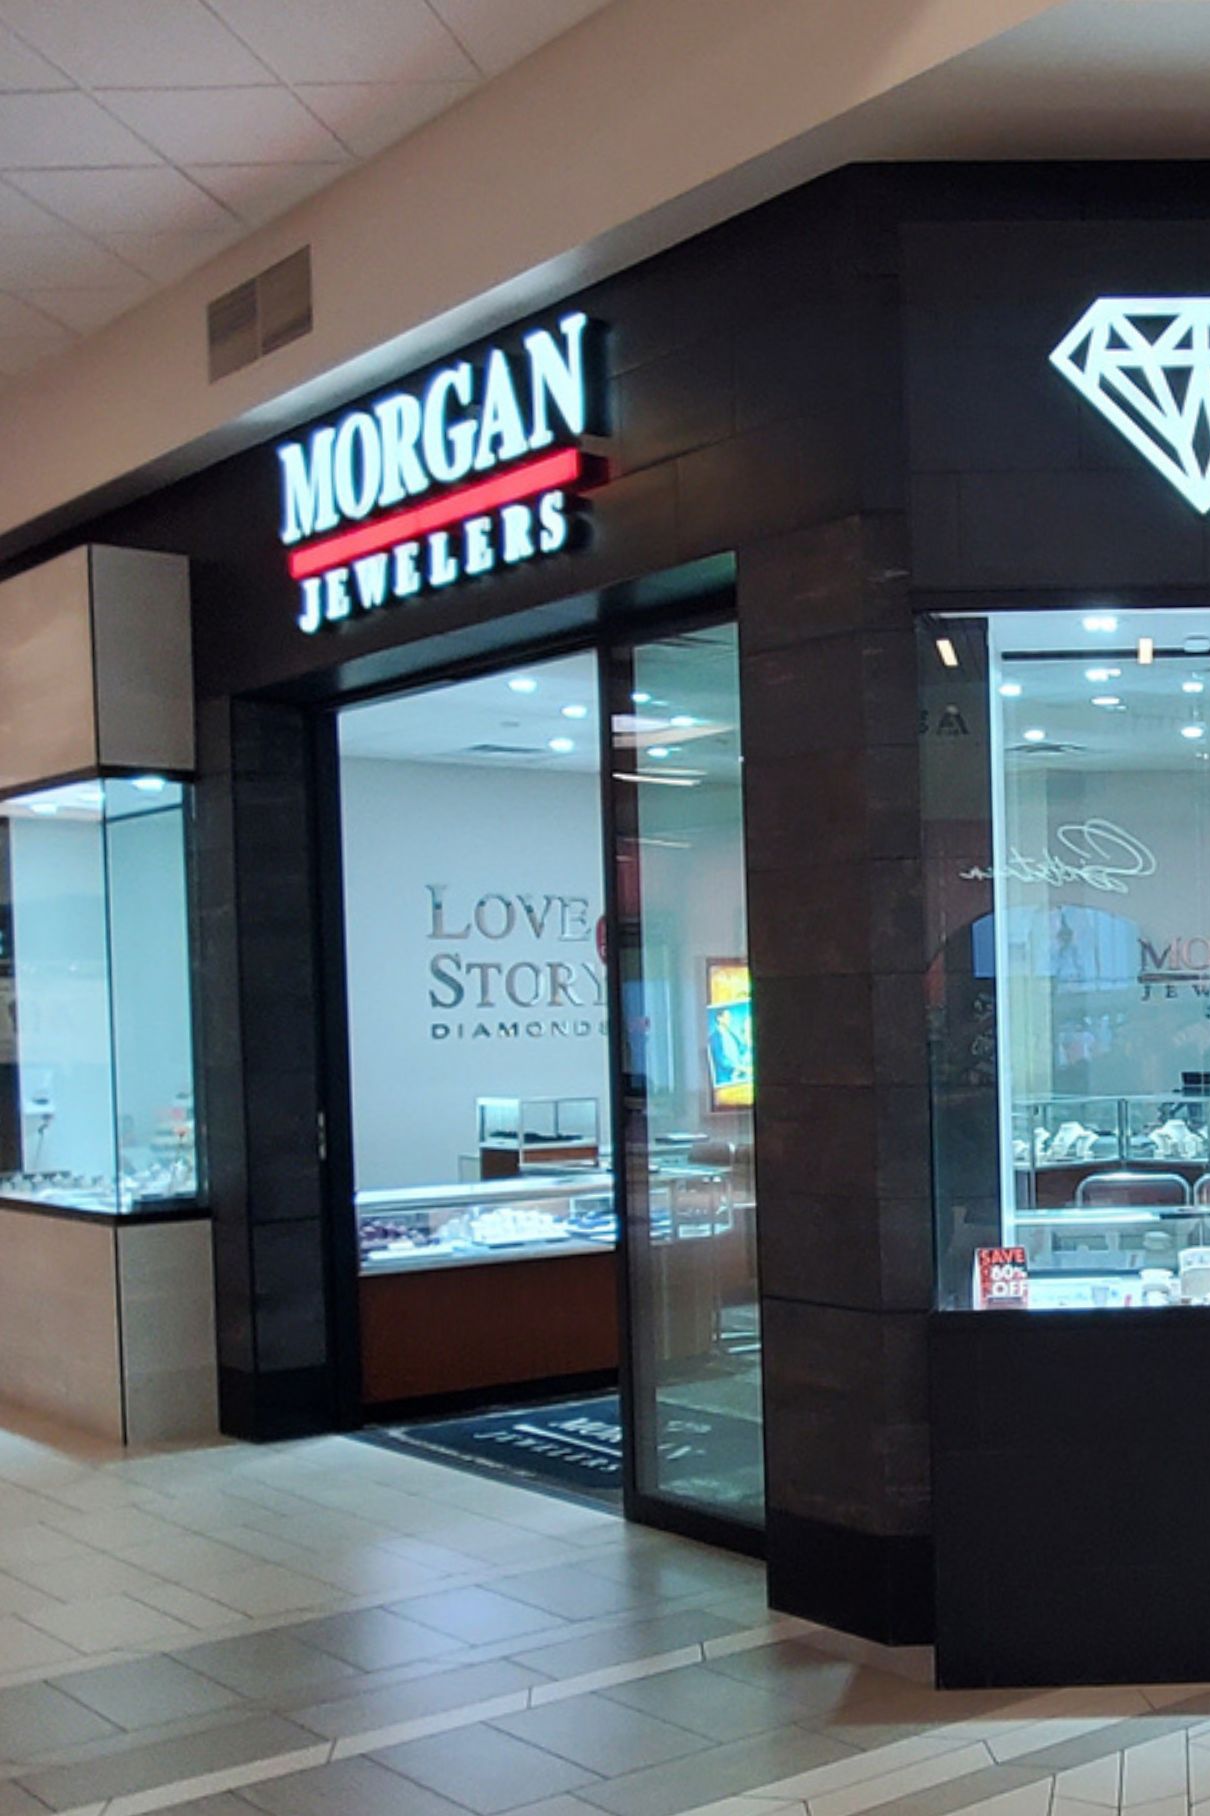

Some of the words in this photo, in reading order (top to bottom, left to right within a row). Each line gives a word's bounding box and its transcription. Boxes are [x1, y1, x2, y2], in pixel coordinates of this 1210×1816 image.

[277, 312, 587, 546] MORGAN
[298, 490, 568, 635] JEWELERS
[425, 884, 591, 942] LOVE
[979, 1248, 1026, 1266] SAVE
[992, 1281, 1029, 1297] OFF
